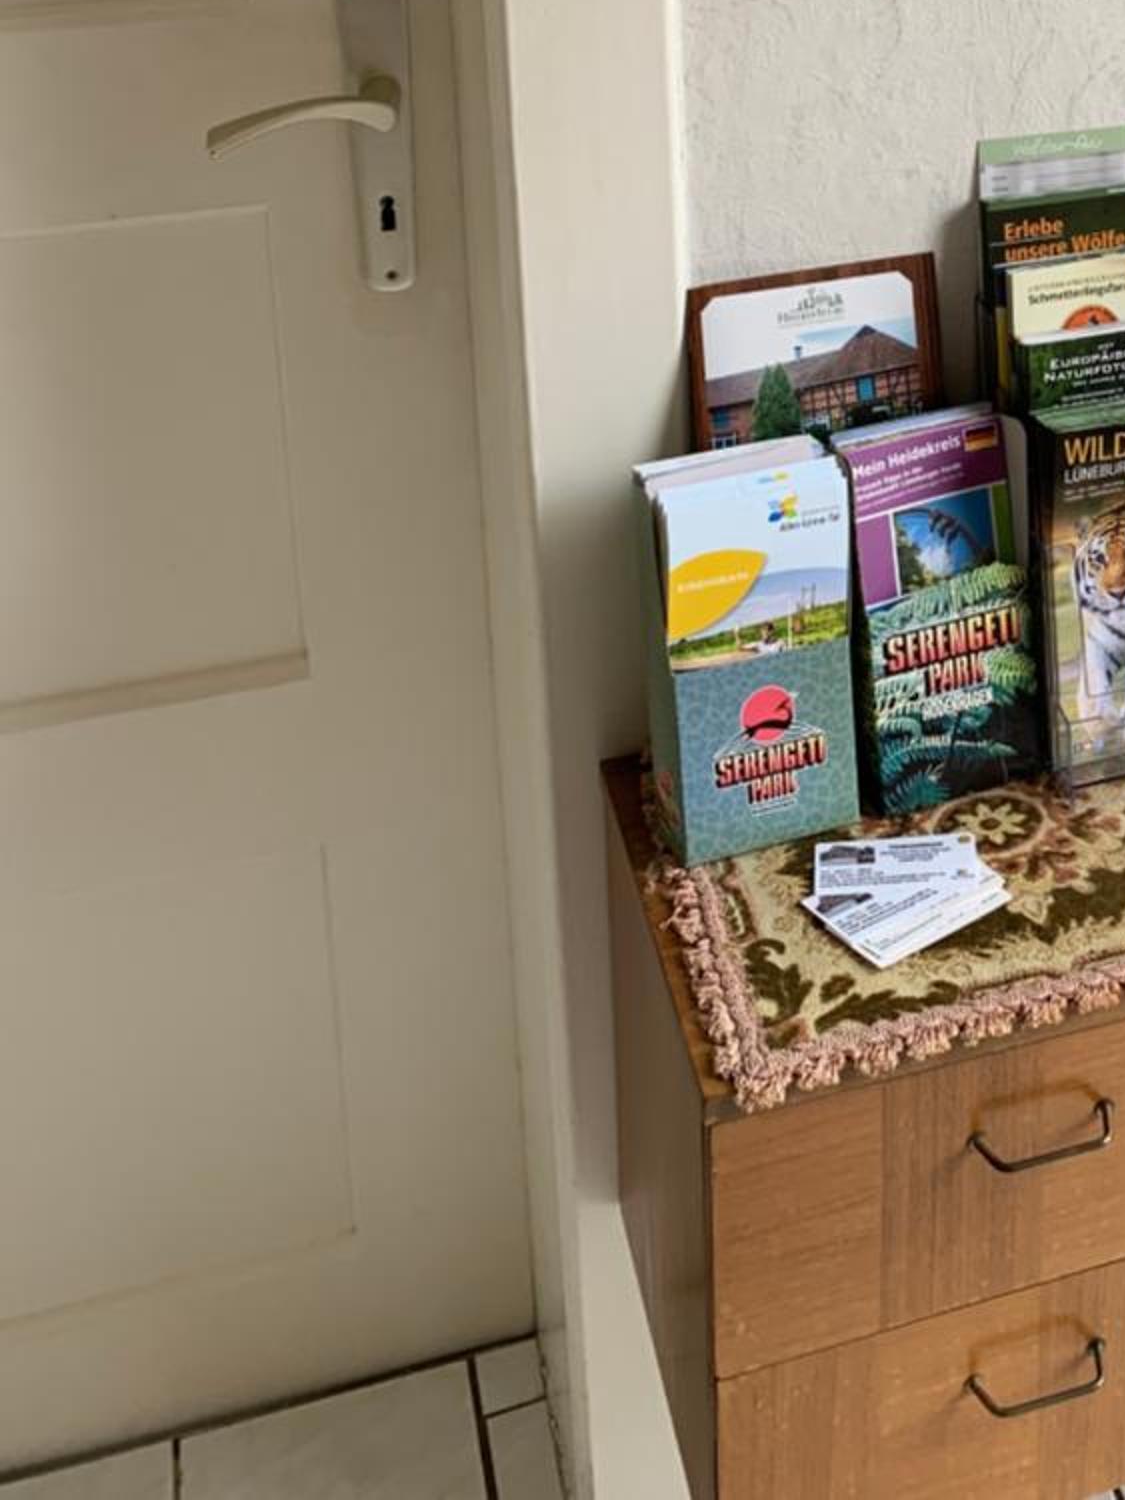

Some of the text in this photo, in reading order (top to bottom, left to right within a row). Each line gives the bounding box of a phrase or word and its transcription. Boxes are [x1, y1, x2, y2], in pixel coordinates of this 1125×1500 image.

[1004, 217, 1065, 241] Erlebe
[1004, 242, 1068, 263] unsere
[852, 435, 961, 481] Mein Heidekreis
[884, 604, 1022, 675] SERENGETI
[925, 651, 992, 697] PARK
[715, 735, 828, 788] SERENGETI
[747, 771, 799, 804] PARK
